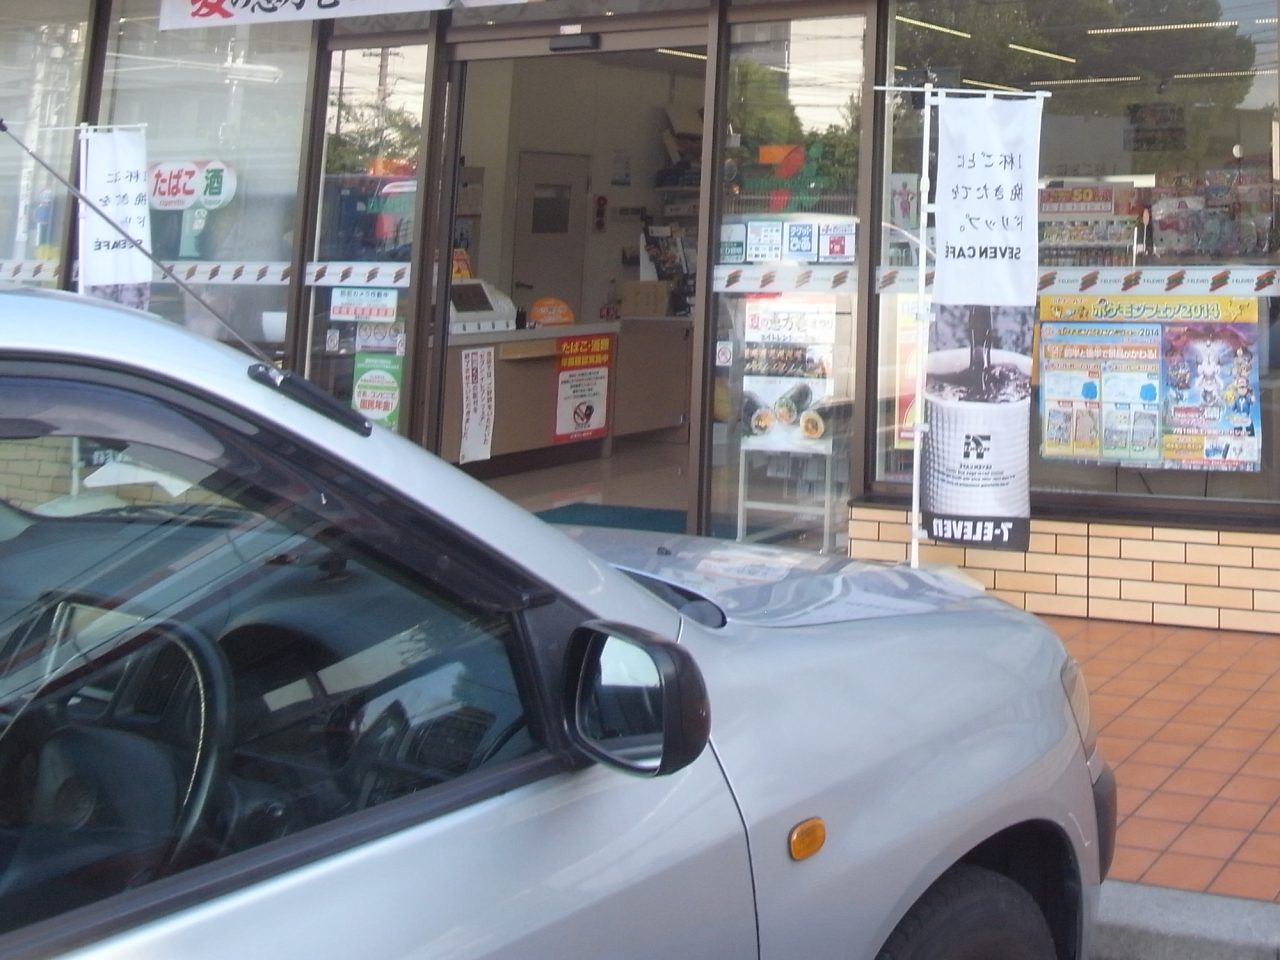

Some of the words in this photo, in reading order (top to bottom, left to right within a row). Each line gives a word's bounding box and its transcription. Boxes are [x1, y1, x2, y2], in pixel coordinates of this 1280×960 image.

[152, 168, 196, 197] たばこ
[203, 168, 225, 196] 酒
[1091, 302, 1221, 320] ポケモンフェア2014
